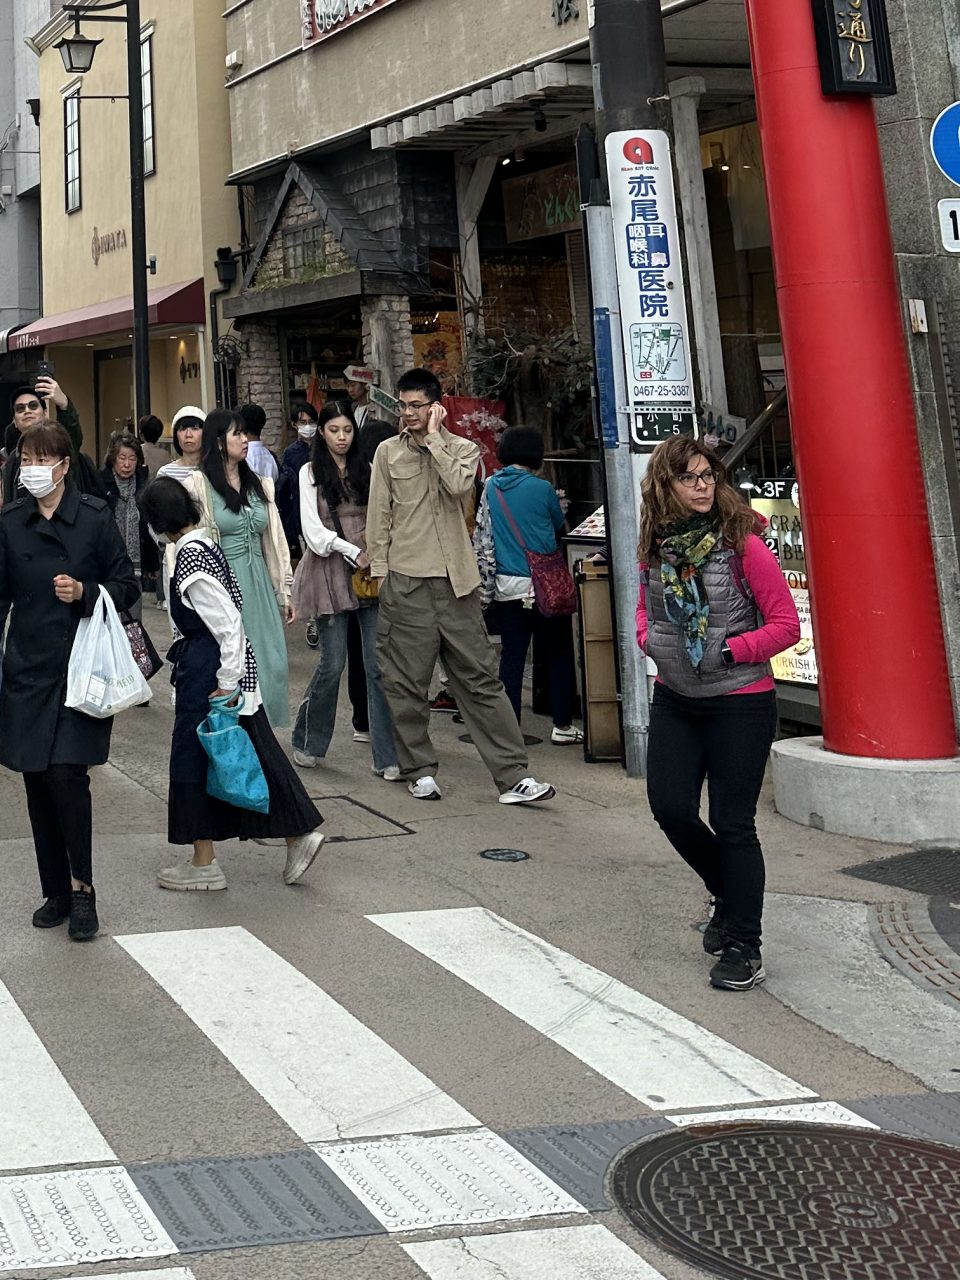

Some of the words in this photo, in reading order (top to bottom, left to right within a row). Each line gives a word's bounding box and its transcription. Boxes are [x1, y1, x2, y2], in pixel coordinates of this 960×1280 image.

[627, 174, 660, 223] 赤尾
[628, 224, 650, 268] 咽喉科
[638, 269, 670, 318] 医院
[633, 385, 690, 397] 0467-25-3387
[653, 425, 681, 436] 1-5
[763, 481, 786, 498] 3F
